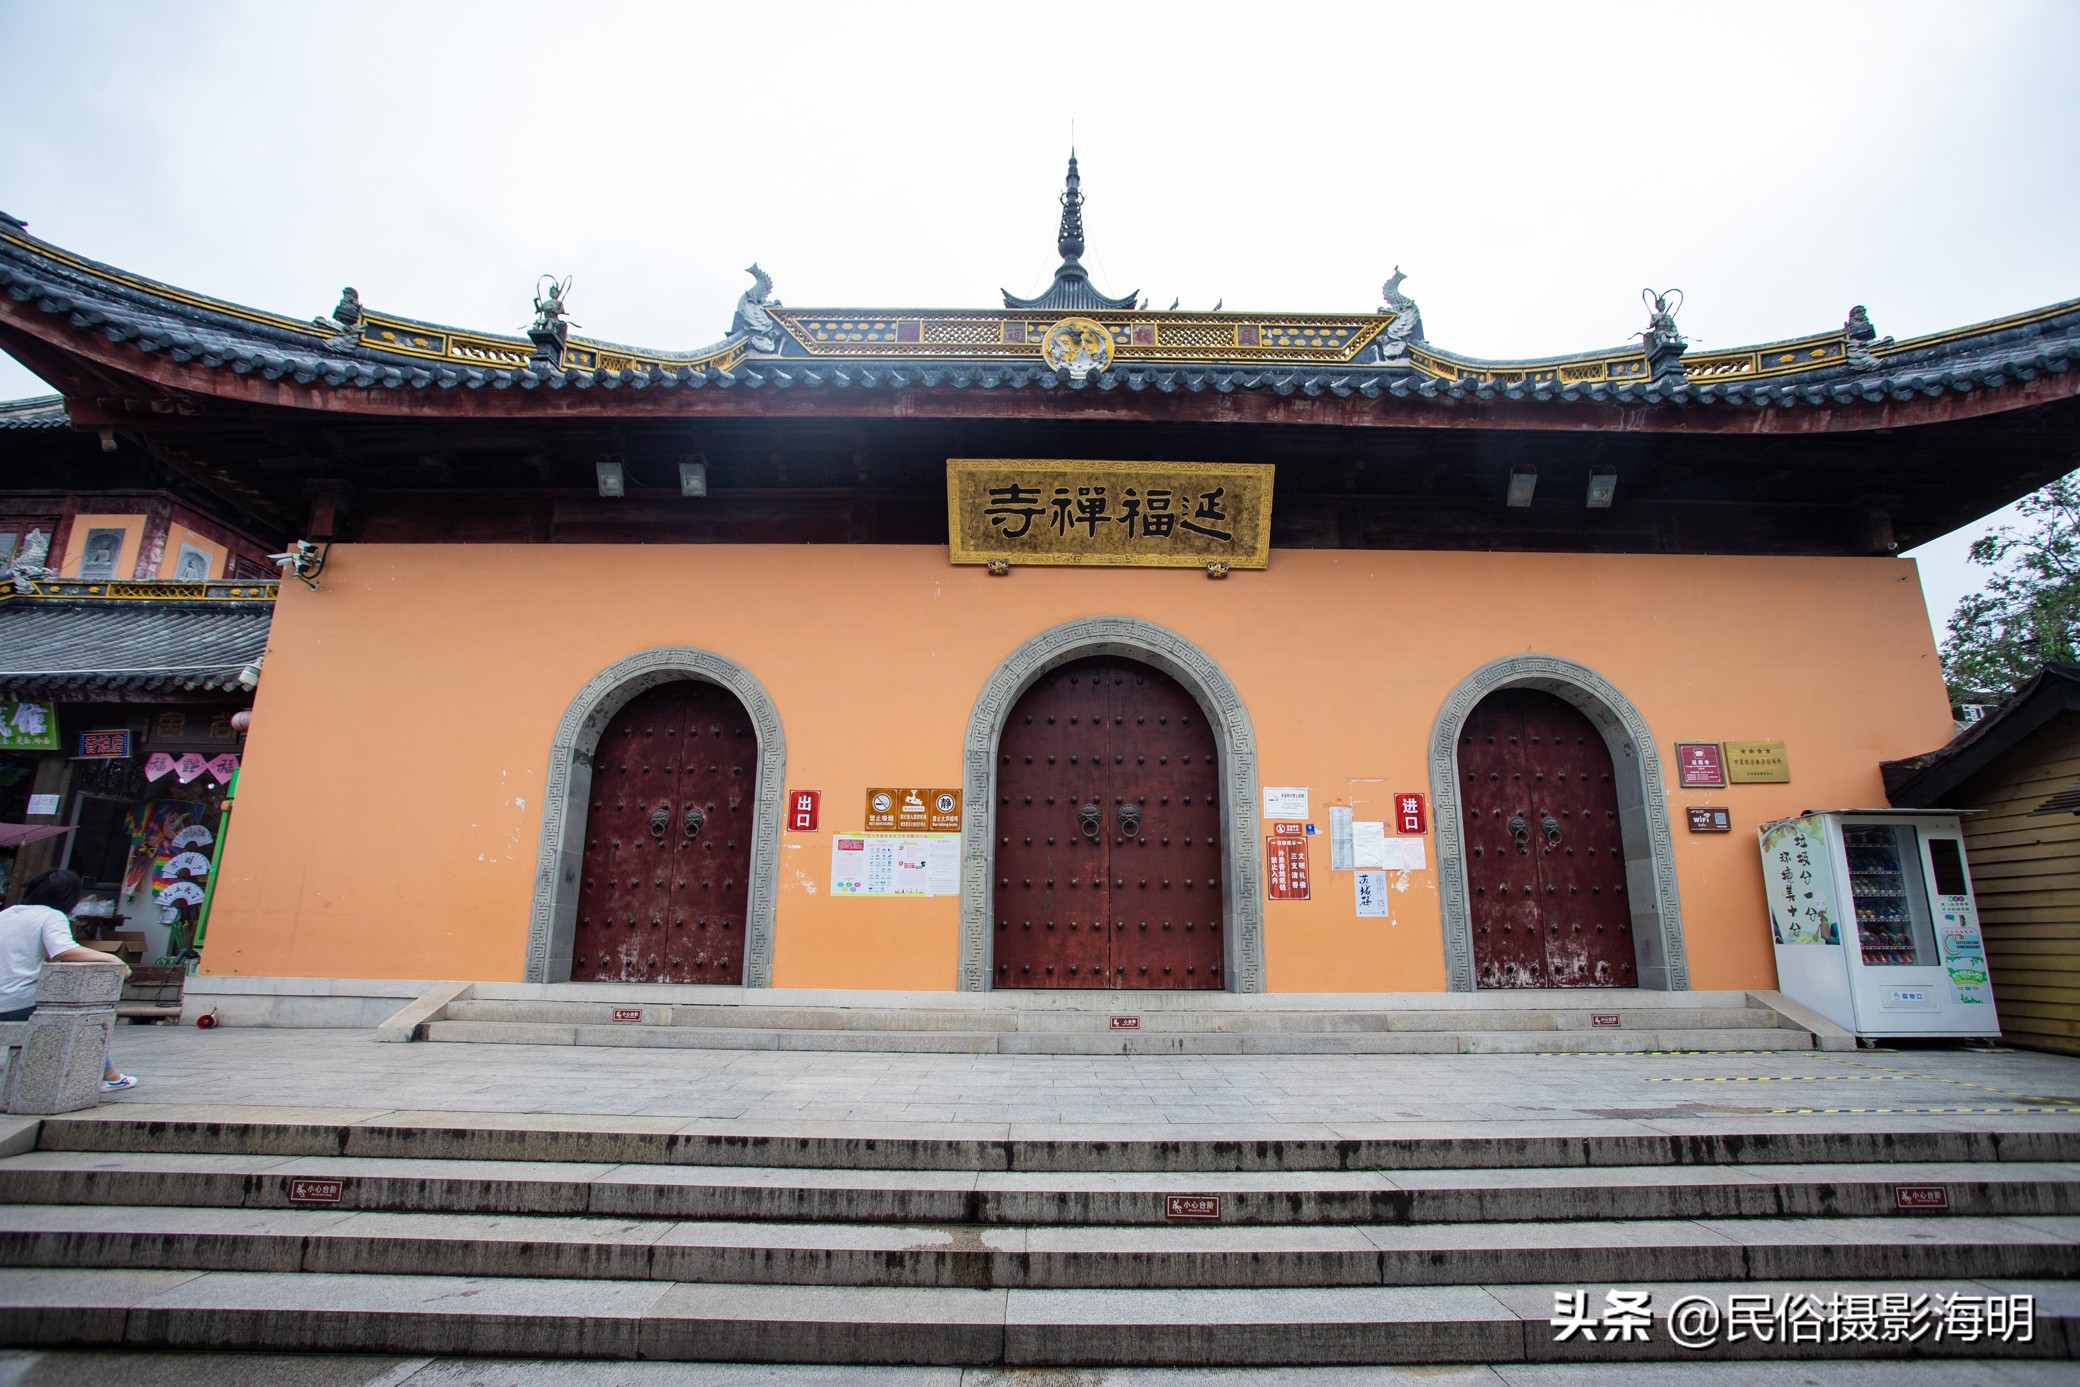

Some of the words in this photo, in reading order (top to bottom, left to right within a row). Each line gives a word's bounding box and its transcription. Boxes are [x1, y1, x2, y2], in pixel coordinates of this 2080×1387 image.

[84, 735, 123, 754] 香烛店
[149, 757, 167, 772] 福
[940, 798, 952, 809] 静
[797, 795, 812, 827] 出口
[1403, 798, 1418, 829] 进口
[307, 1184, 338, 1194] 小心台阶
[1911, 1191, 1941, 1200] 小心台阶
[1183, 1201, 1214, 1210] 小心台阶
